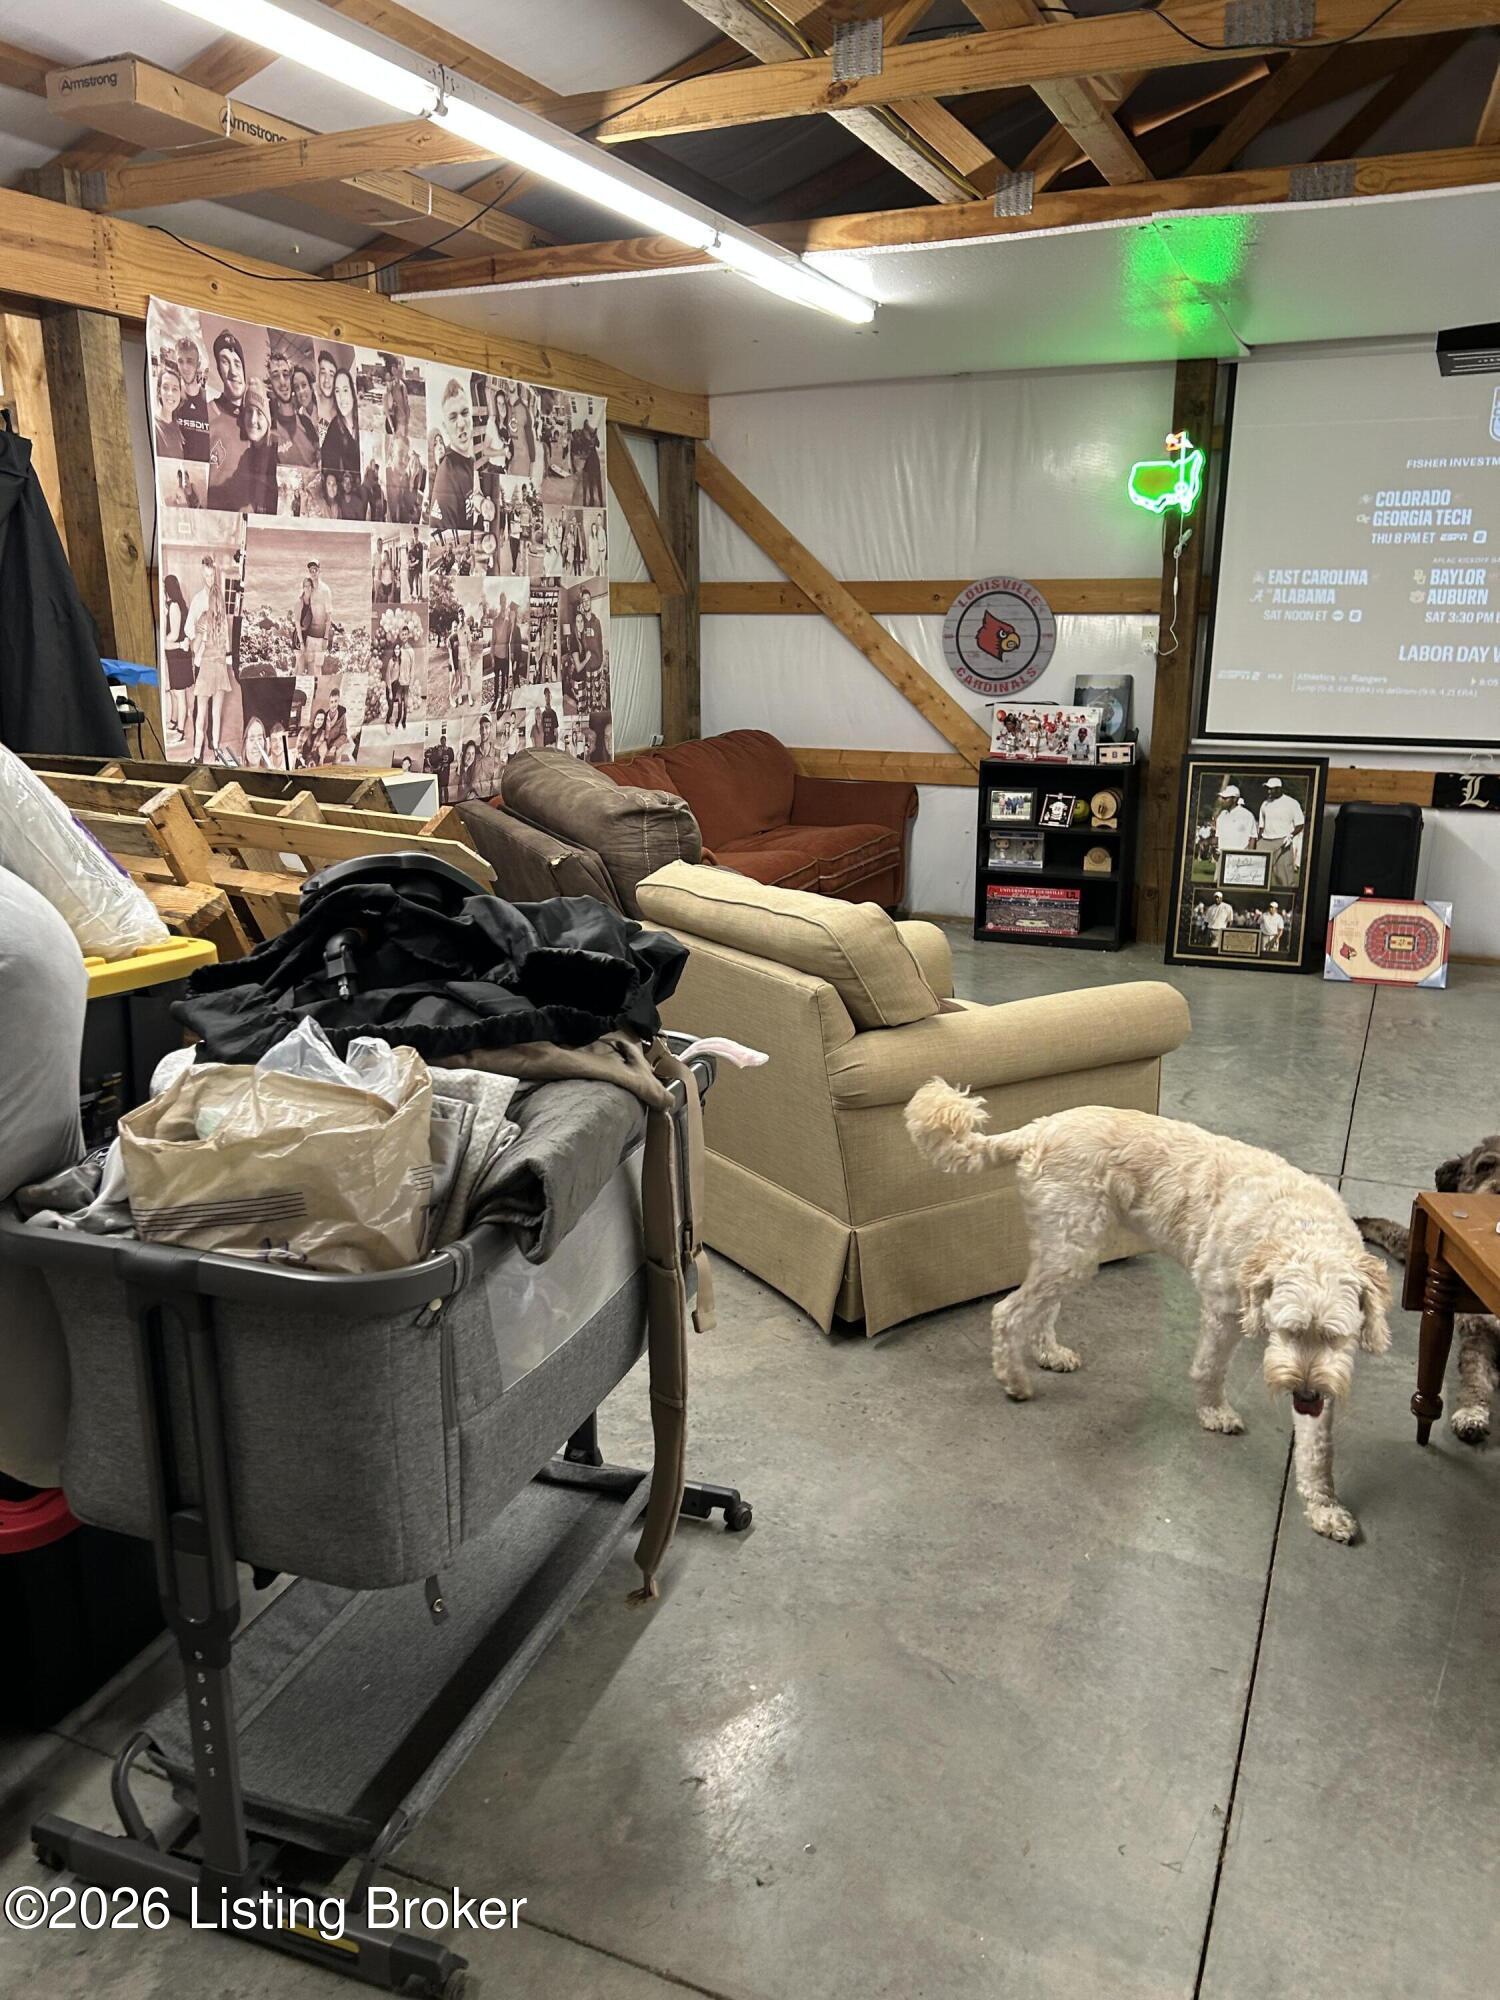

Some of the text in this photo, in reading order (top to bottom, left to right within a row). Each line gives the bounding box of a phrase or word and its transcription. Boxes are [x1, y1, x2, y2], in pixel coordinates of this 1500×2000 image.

[61, 72, 118, 92] Armstrong
[1406, 458, 1447, 469] FISHER
[1375, 489, 1452, 507] COLORADO
[1372, 509, 1432, 527] GEORGIA
[1435, 508, 1473, 526] TECH
[1371, 532, 1393, 544] THU
[1403, 532, 1421, 544] PM
[1422, 532, 1437, 544] ET
[1268, 568, 1369, 586] EAST CAROLINA
[1429, 568, 1487, 585] BAYLOR
[958, 579, 1041, 608] LOUISVILLE
[1272, 588, 1336, 604] ALABAMA
[1426, 588, 1489, 605] AUBURN
[1263, 609, 1281, 621] SAT
[1284, 610, 1314, 621] NOON
[1315, 610, 1328, 621] ET
[1424, 611, 1447, 623] SAT
[1448, 611, 1475, 624] 3:30
[1476, 611, 1495, 624] PM
[1398, 645, 1454, 662] LABOR
[1456, 645, 1490, 663] DAY
[956, 667, 1037, 693] CARDINALS
[1459, 775, 1489, 808] L
[205, 1743, 215, 1754] 2
